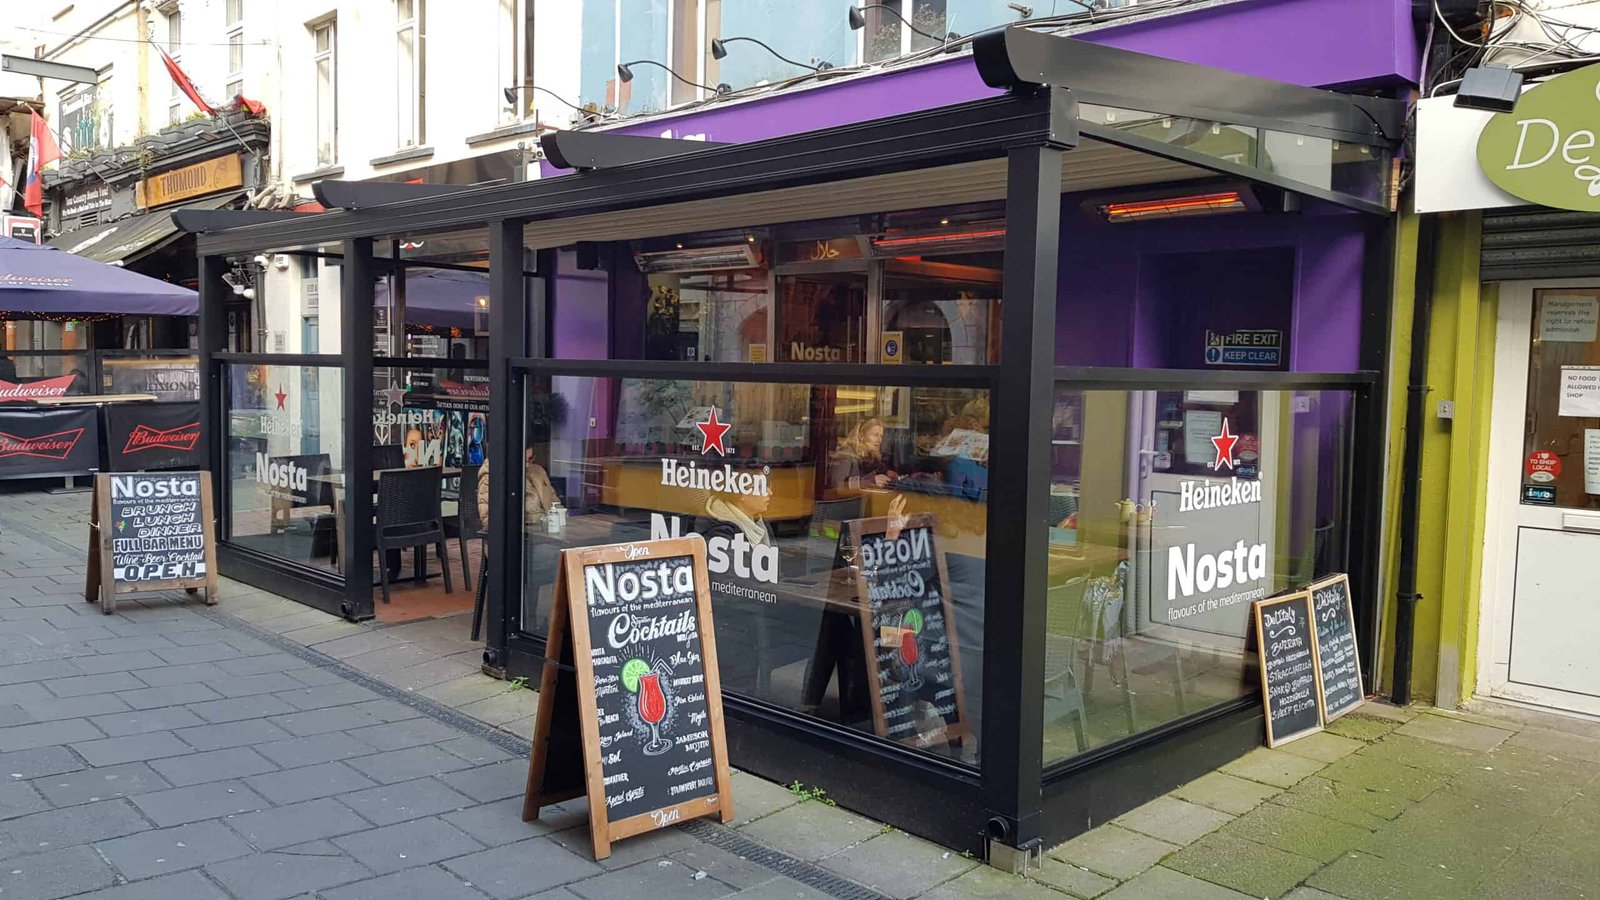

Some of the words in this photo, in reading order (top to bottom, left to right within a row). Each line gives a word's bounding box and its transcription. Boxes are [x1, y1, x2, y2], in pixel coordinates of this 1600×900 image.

[160, 166, 207, 196] THOMOND
[1225, 333, 1250, 345] FIRE
[1253, 333, 1279, 345] EXIT
[791, 341, 841, 361] Nosta
[1224, 351, 1247, 360] KEEP
[1248, 351, 1277, 361] CLEAR
[130, 430, 200, 447] Budweiser
[256, 452, 307, 492] Nosta
[661, 458, 769, 497] Heineken
[110, 475, 197, 498] Nosta
[1180, 476, 1261, 512] Heineken
[121, 502, 196, 517] BRUNCH
[133, 513, 194, 528] LUNCH
[138, 523, 202, 538] DINNER
[113, 538, 141, 553] FULL
[142, 537, 168, 551] BAR
[168, 535, 203, 550] MENU
[620, 543, 650, 560] Open
[651, 513, 779, 584] Nsta
[141, 553, 166, 563] Beer
[167, 550, 204, 563] Cocktail
[123, 561, 198, 581] OPEN
[1167, 539, 1266, 600] Nosta
[585, 562, 694, 605] Nosta
[712, 581, 777, 604] mediterranean
[590, 606, 620, 618] flavours
[621, 603, 629, 612] of
[629, 602, 642, 612] the
[643, 597, 693, 609] mediterranean
[1168, 604, 1197, 620] flavours
[1198, 599, 1206, 613] of
[1207, 598, 1219, 611] the
[1219, 587, 1265, 607] mediterranean
[608, 609, 695, 649] Cocktails
[675, 730, 709, 744] JAMESON
[685, 740, 710, 753] MOJITO
[651, 809, 680, 827] Open
